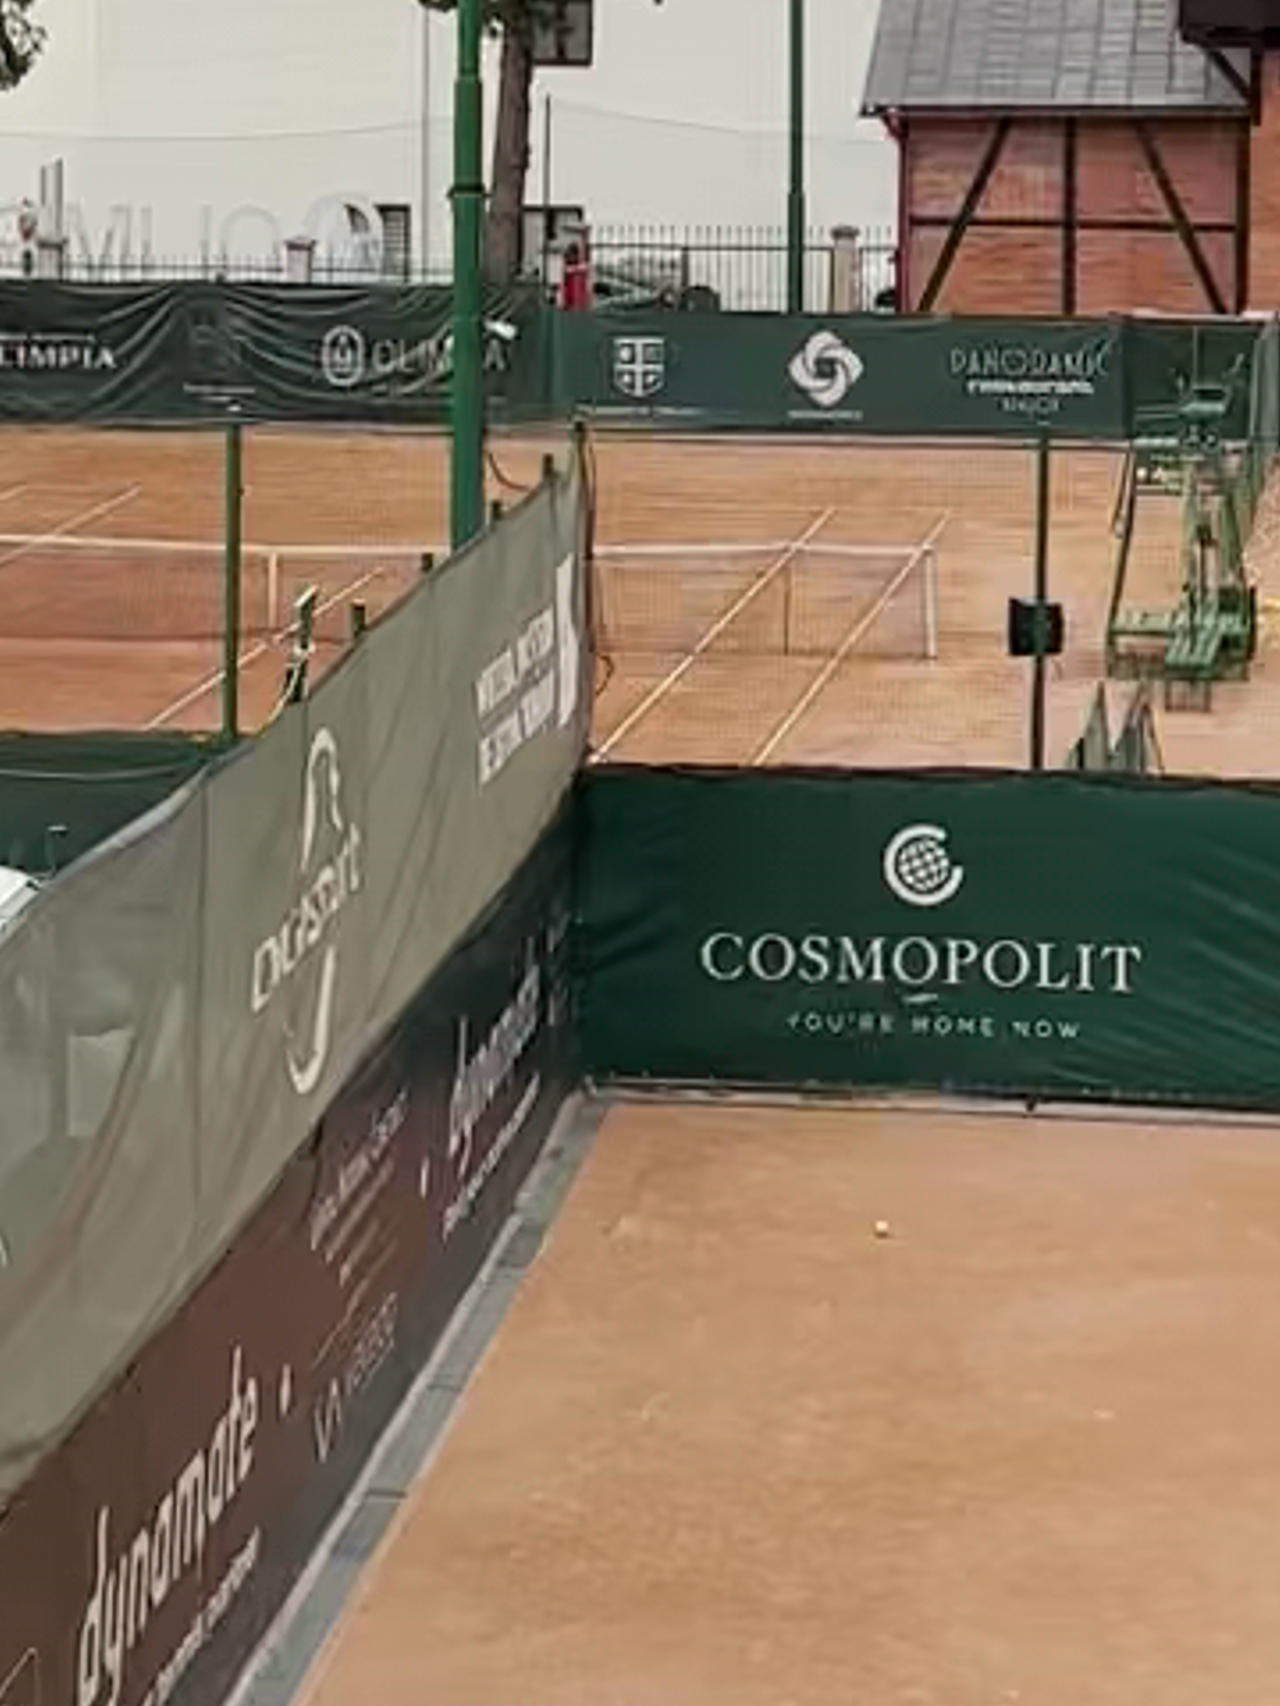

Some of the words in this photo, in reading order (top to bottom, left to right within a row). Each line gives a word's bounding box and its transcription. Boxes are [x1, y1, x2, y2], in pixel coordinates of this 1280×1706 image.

[373, 338, 505, 374] OLIMA
[700, 932, 1142, 992] COSMOPOLIT
[911, 1016, 996, 1038] HOME
[1013, 1020, 1082, 1039] NOW
